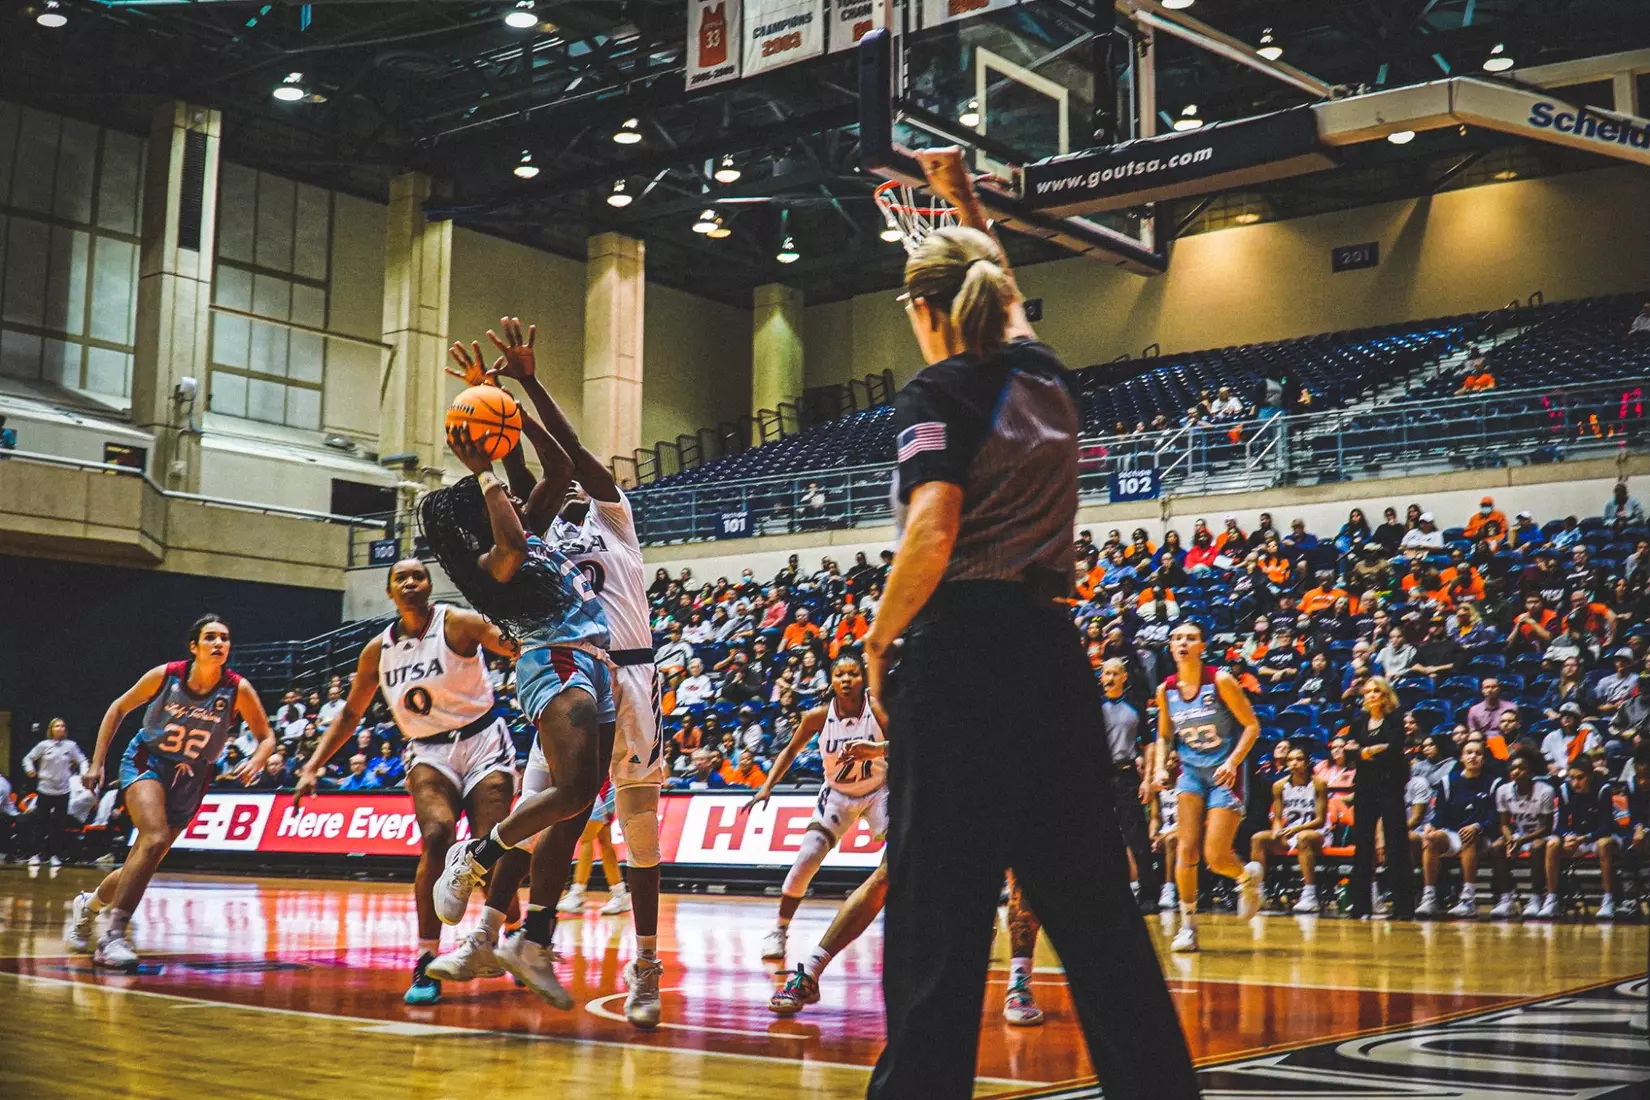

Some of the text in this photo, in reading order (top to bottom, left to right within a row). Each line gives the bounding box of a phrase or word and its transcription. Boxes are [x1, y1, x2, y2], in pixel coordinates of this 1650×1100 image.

[752, 11, 813, 39] CHAMPIONS
[1036, 147, 1213, 194] www.goutsa.com
[1341, 249, 1370, 264] 201
[1117, 476, 1152, 495] 102
[723, 517, 746, 533] 101
[374, 545, 395, 559] 100
[384, 657, 444, 688] UTSA
[404, 686, 433, 717] 0
[158, 722, 212, 760] 32
[277, 806, 344, 840] Here
